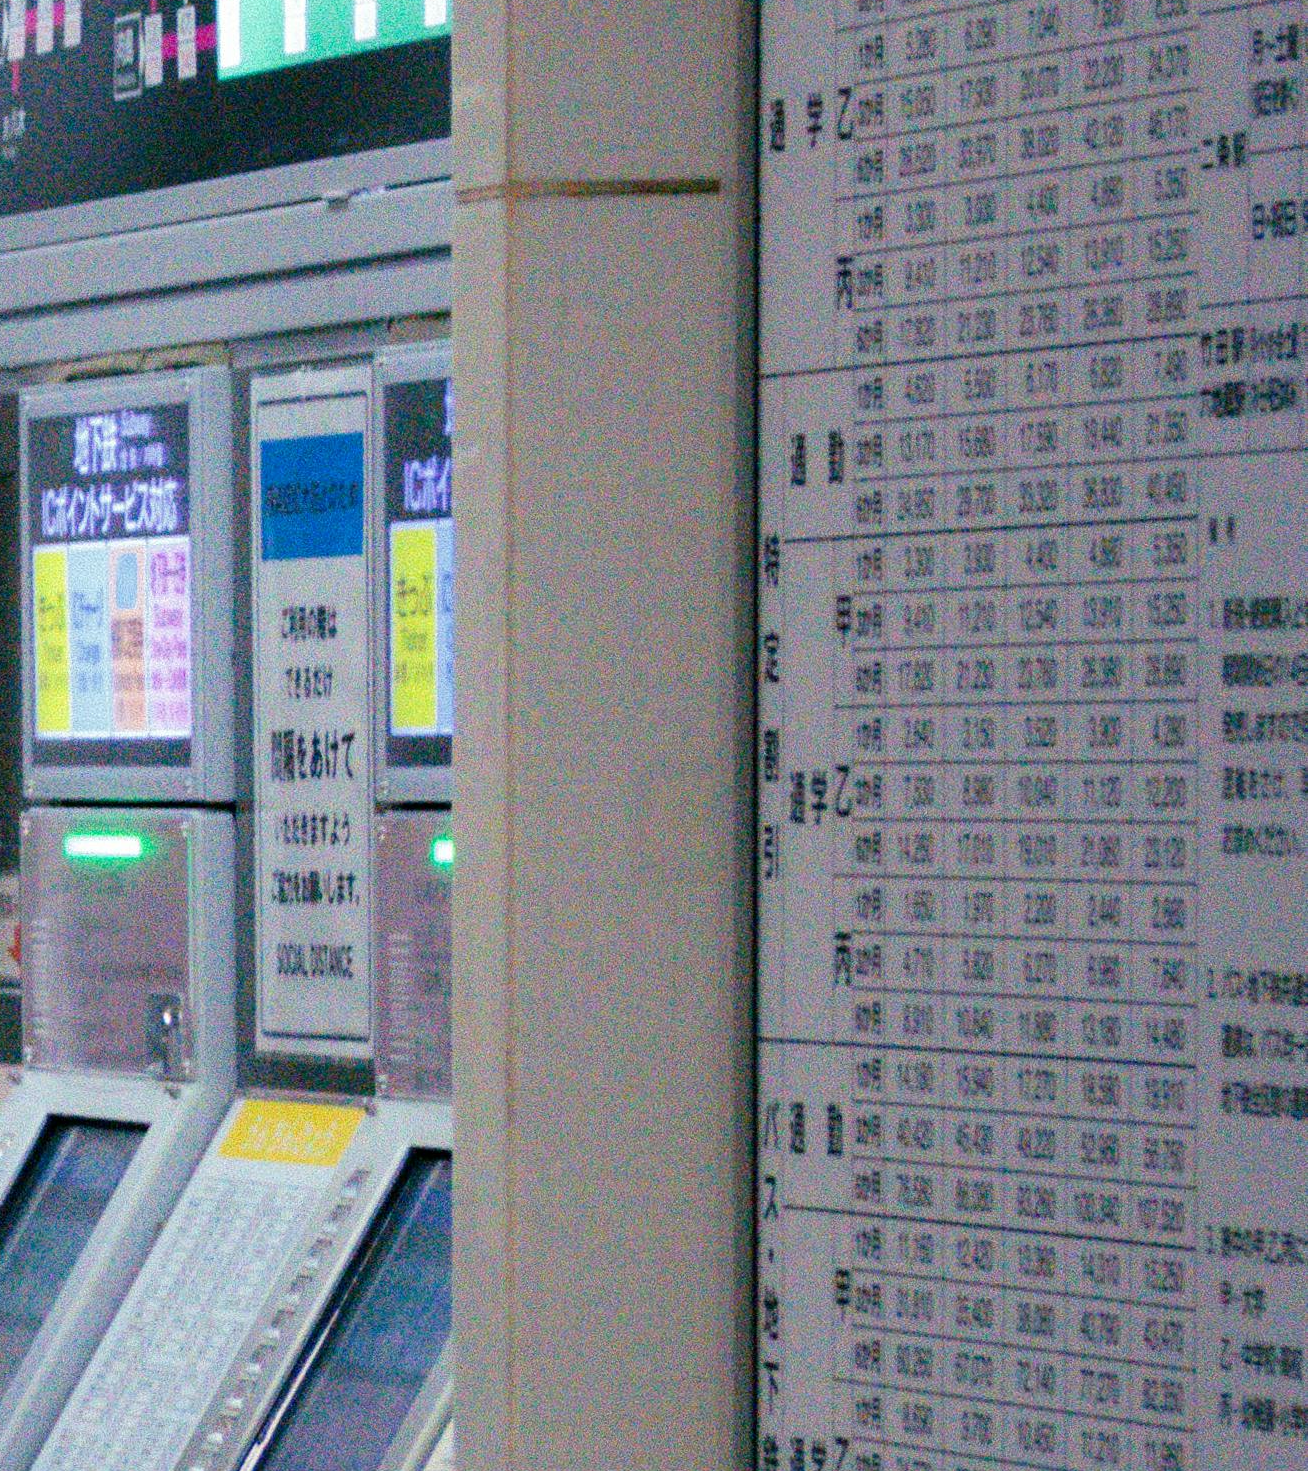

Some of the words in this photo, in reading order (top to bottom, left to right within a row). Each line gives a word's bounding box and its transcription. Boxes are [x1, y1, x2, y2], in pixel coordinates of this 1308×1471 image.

[271, 729, 356, 782] 間隔をあけて
